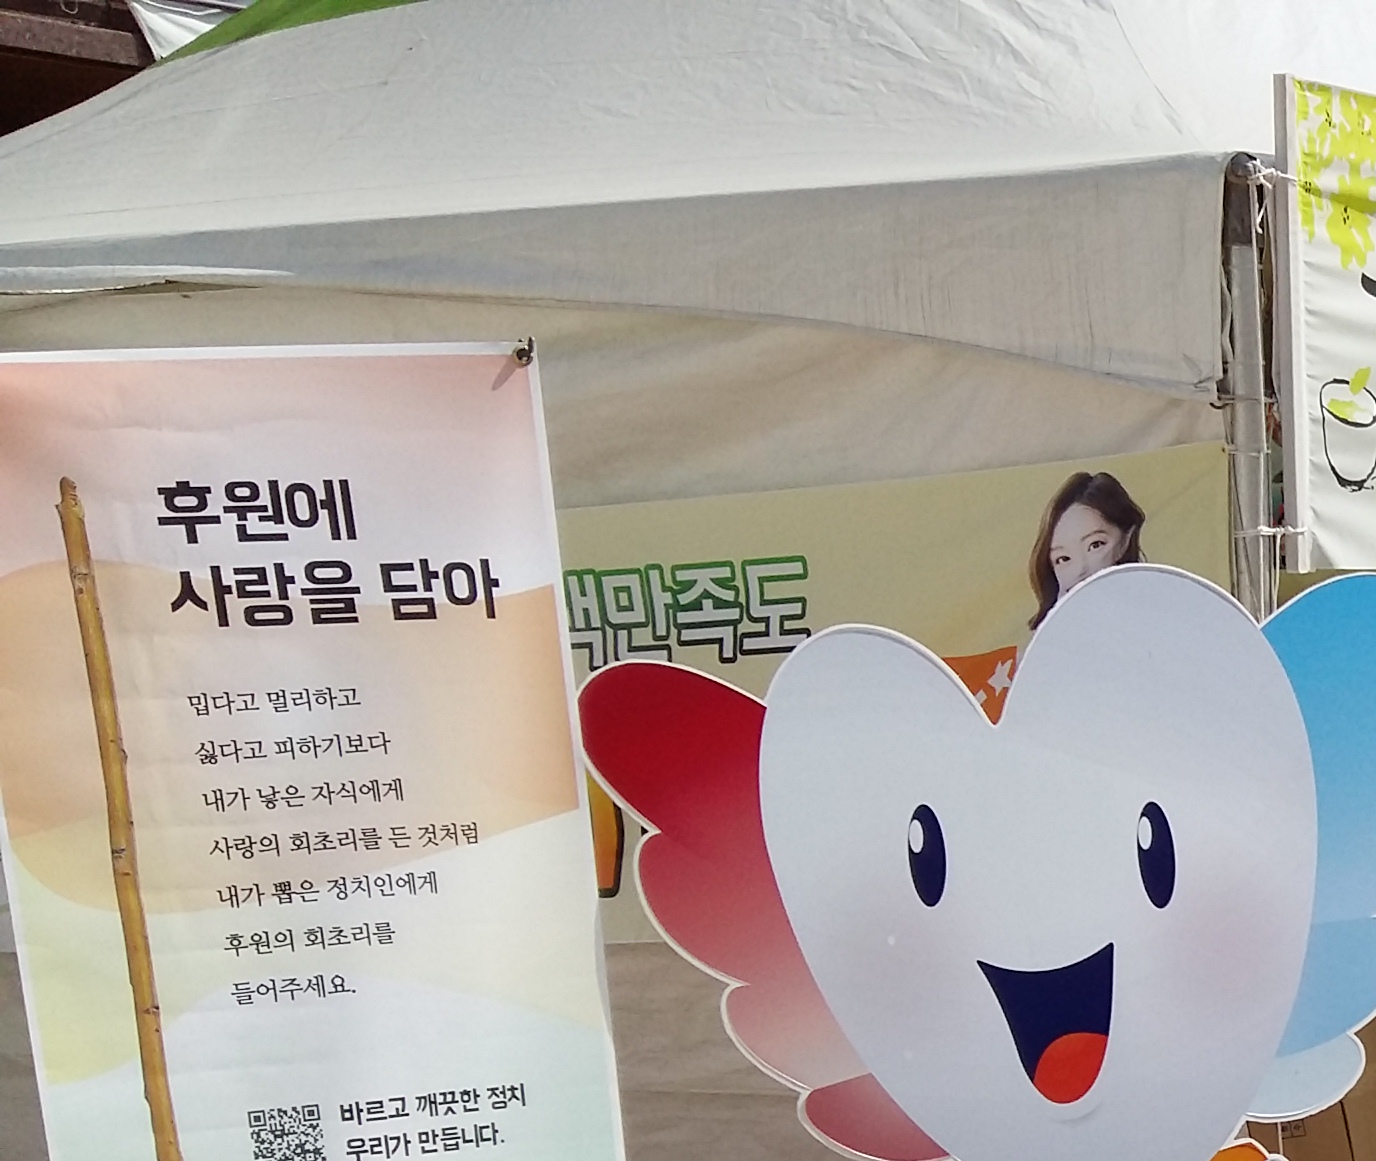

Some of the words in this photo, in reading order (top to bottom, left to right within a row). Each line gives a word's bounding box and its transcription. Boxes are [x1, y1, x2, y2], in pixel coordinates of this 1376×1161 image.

[157, 479, 358, 545] 후원에
[170, 561, 362, 628] 사랑을
[380, 557, 500, 621] 담아
[187, 690, 260, 717] 밉다고
[265, 685, 362, 713] 멀리하고
[194, 738, 268, 765] 싫다고
[274, 731, 391, 761] 피하기보다
[202, 786, 251, 814] 내가
[256, 784, 306, 810] 낳은
[310, 777, 404, 806] 자식에게
[209, 833, 281, 861] 사랑의
[289, 827, 382, 855] 회초리를
[388, 825, 413, 849] 든
[417, 821, 480, 849] 것처럼
[217, 881, 265, 909] 내가
[271, 878, 321, 904] 뽑은
[326, 871, 439, 901] 정치인에게
[224, 928, 296, 957] 후원의
[304, 922, 396, 951] 회초리를
[231, 973, 357, 1006] 들어주세요.
[339, 1097, 410, 1126] 바르고
[415, 1088, 480, 1117] 깨끗한
[486, 1083, 526, 1110] 정치
[417, 1122, 505, 1155] 만듭니다.
